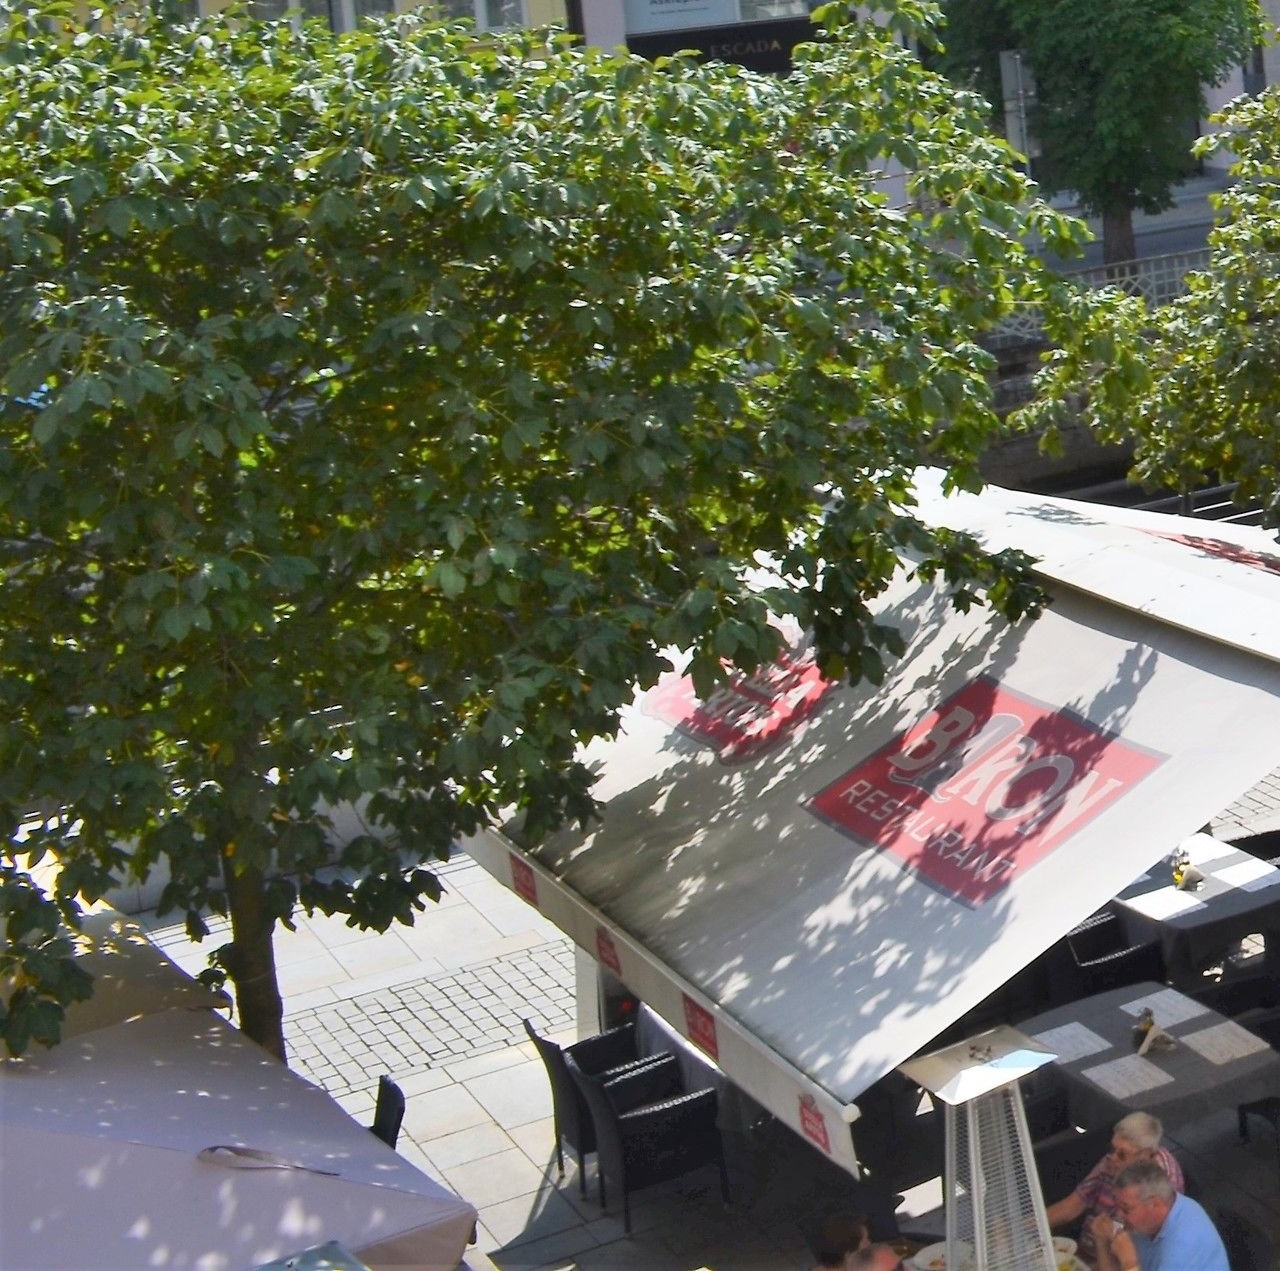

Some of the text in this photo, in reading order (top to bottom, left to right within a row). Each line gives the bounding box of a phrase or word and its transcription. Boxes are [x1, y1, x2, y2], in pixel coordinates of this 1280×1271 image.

[709, 39, 782, 58] ESCADA
[886, 706, 1124, 847] BARON
[839, 778, 1018, 882] RESTAURANT
